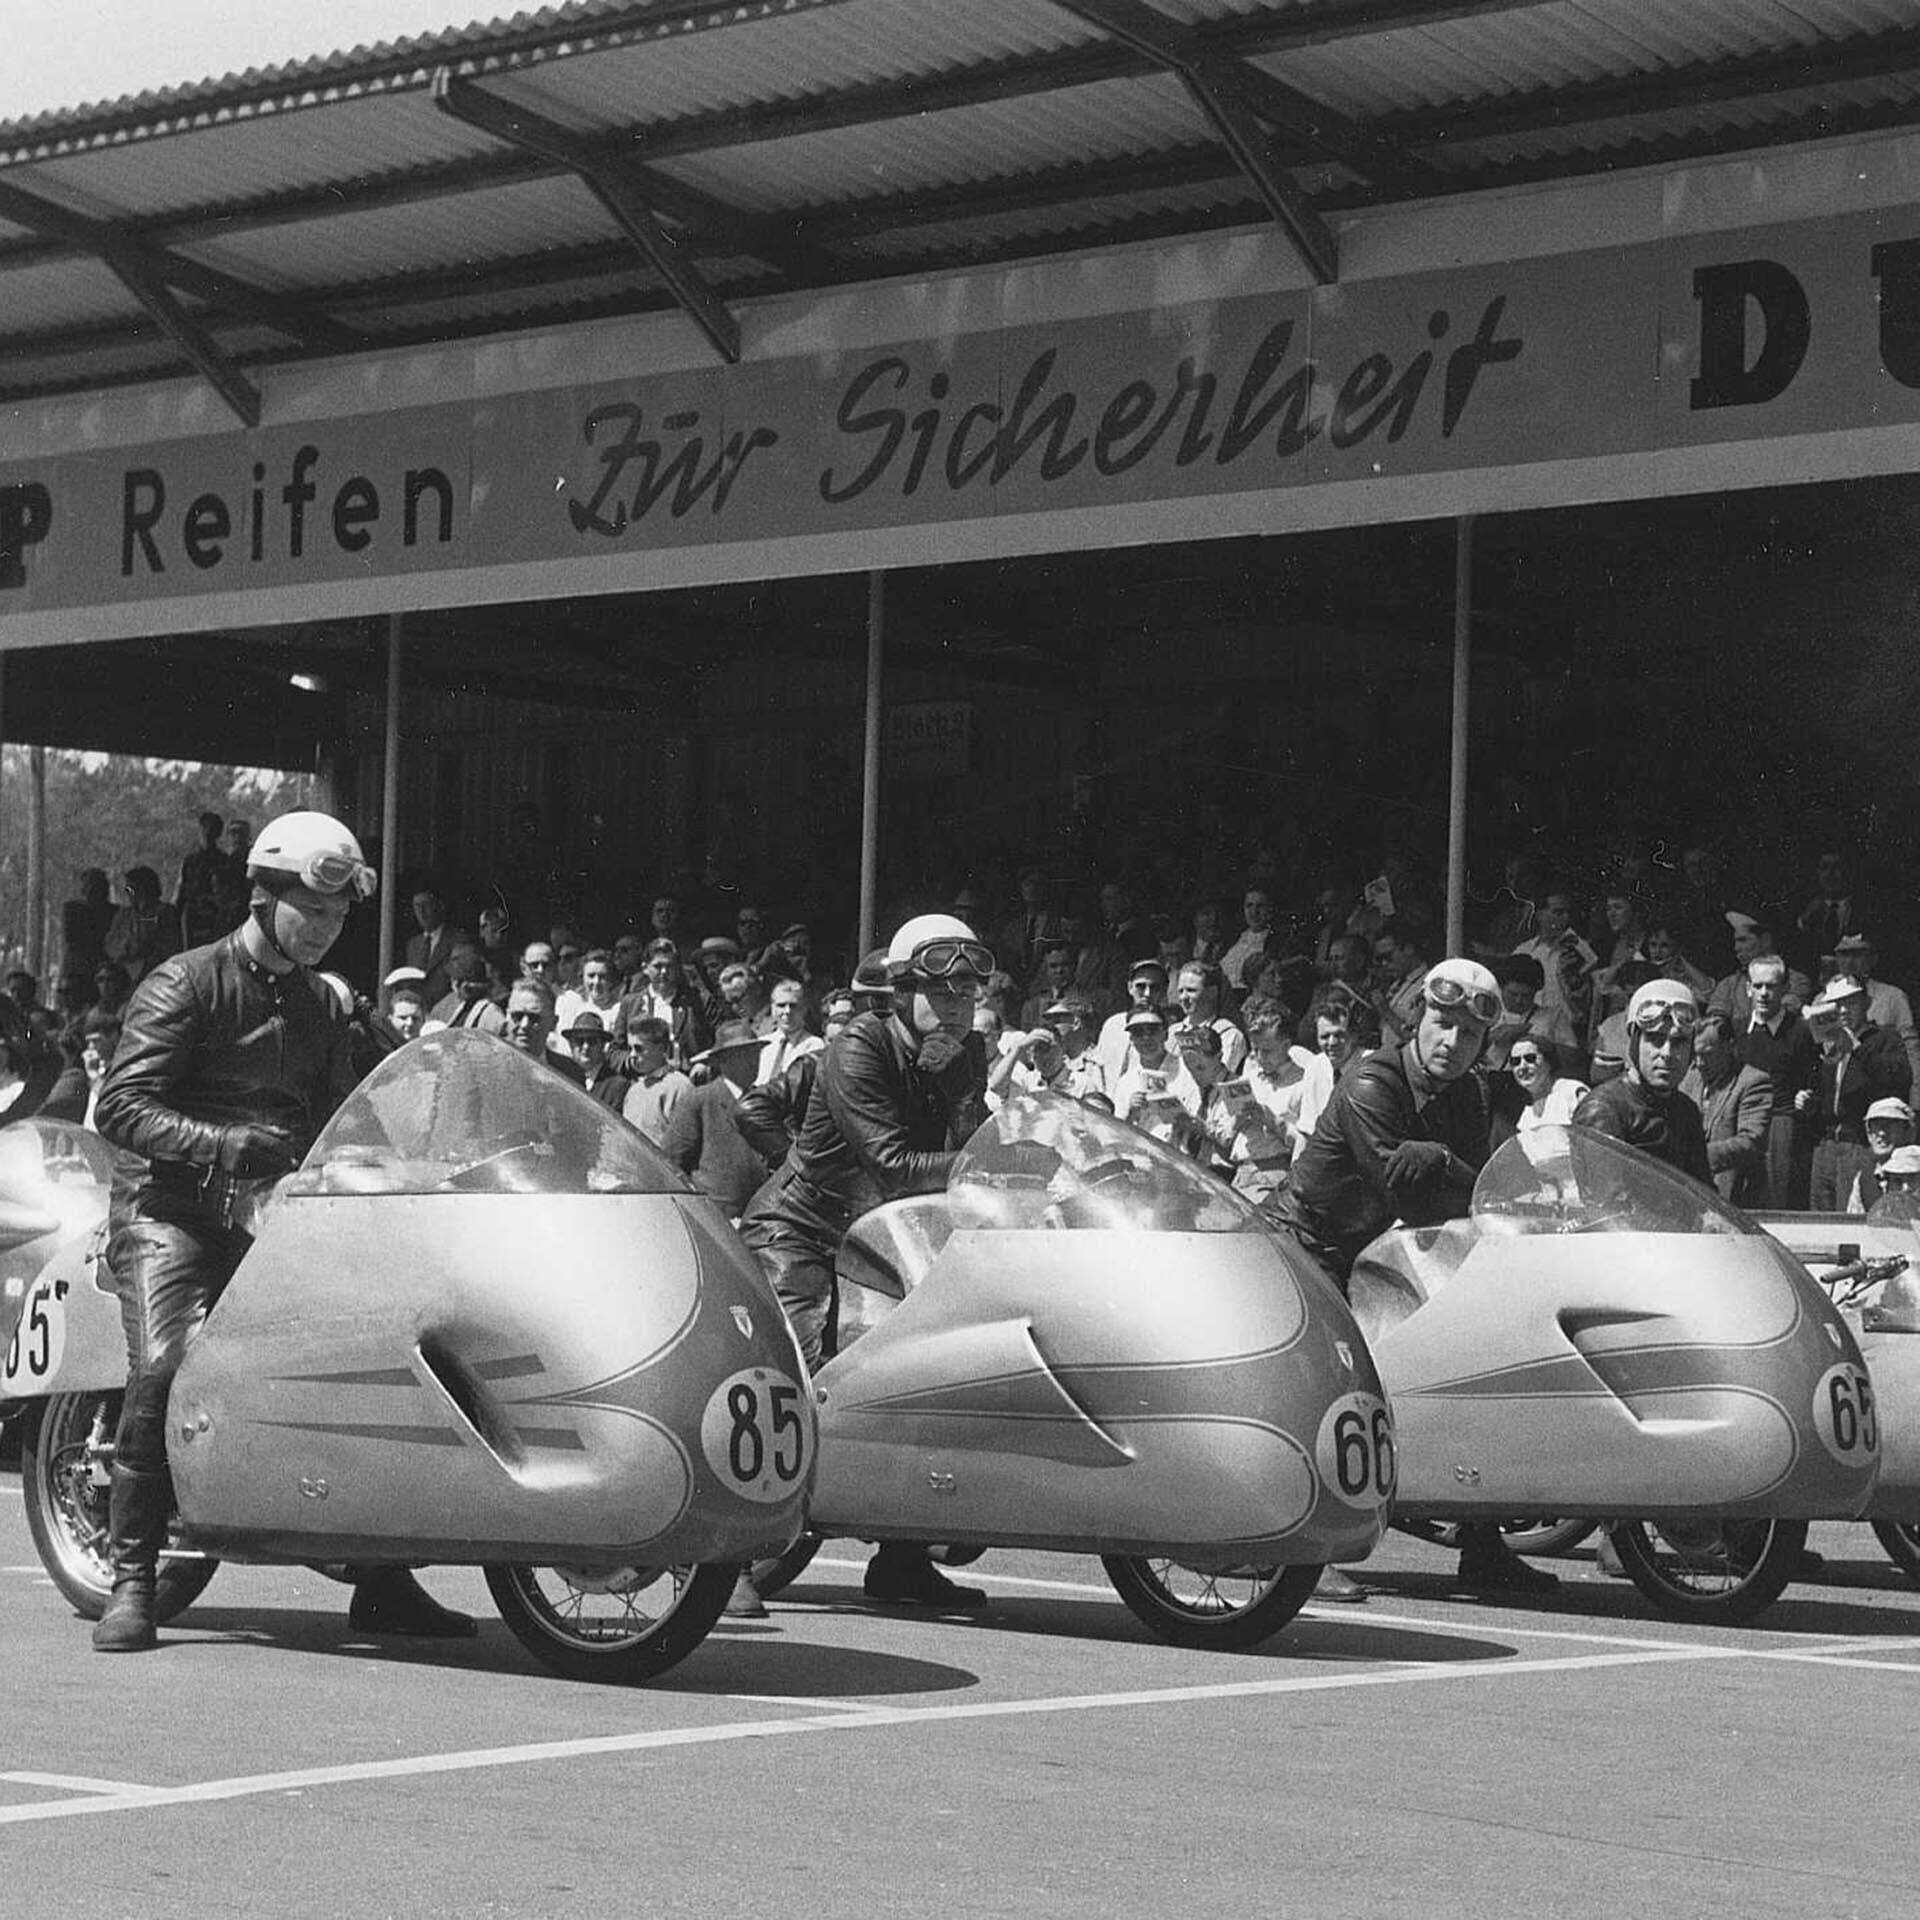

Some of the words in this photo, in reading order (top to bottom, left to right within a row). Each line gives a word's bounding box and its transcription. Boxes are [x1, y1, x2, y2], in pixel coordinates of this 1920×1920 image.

[819, 294, 1524, 502] Sicherheit
[121, 444, 454, 576] Reifen
[727, 1383, 803, 1482] 85
[1334, 1408, 1394, 1496] 66
[1829, 1375, 1876, 1453] 65
